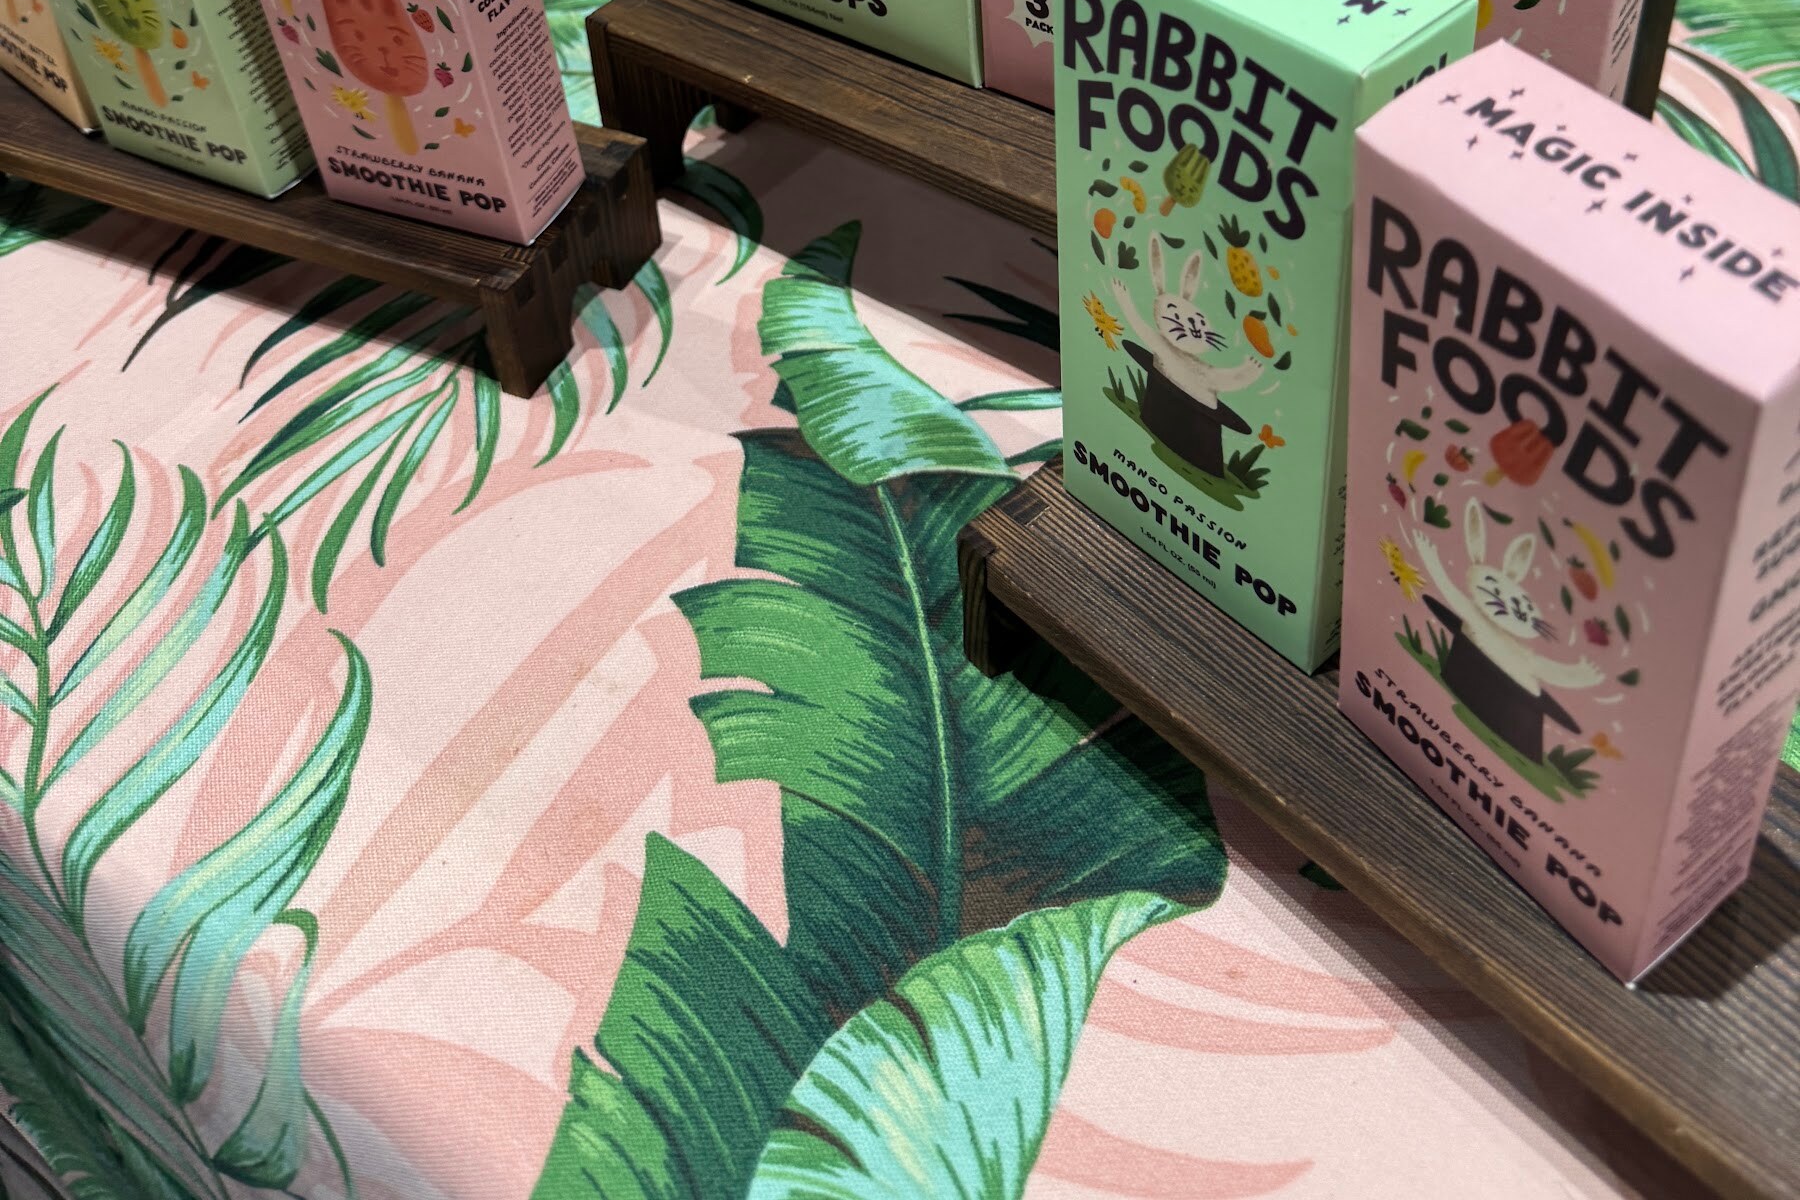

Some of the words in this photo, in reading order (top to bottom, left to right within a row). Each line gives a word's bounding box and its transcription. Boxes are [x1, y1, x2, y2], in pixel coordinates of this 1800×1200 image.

[1025, 17, 1054, 36] PACK
[102, 104, 201, 153] SMOOTHIE
[206, 140, 248, 166] POP
[327, 156, 452, 202] SMOOTHIE
[458, 189, 507, 214] POP
[336, 144, 424, 174] STRAWBERRY
[429, 166, 486, 187] BANANA
[1077, 79, 1320, 240] FOODS
[1464, 96, 1622, 191] MAGIC
[1622, 189, 1800, 303] INSIDE
[1367, 195, 1730, 481] RABBIT
[1113, 448, 1169, 495] MANGO
[1173, 494, 1247, 551] PASSION
[1381, 308, 1697, 560] FOODS
[1073, 440, 1221, 570] SMOOTHIE
[1234, 563, 1297, 617] POP
[1355, 670, 1531, 851] SMOOTHIE
[1546, 853, 1623, 926] POP
[1374, 668, 1504, 788] STRAWBERRY
[1509, 794, 1602, 877] BANANA
